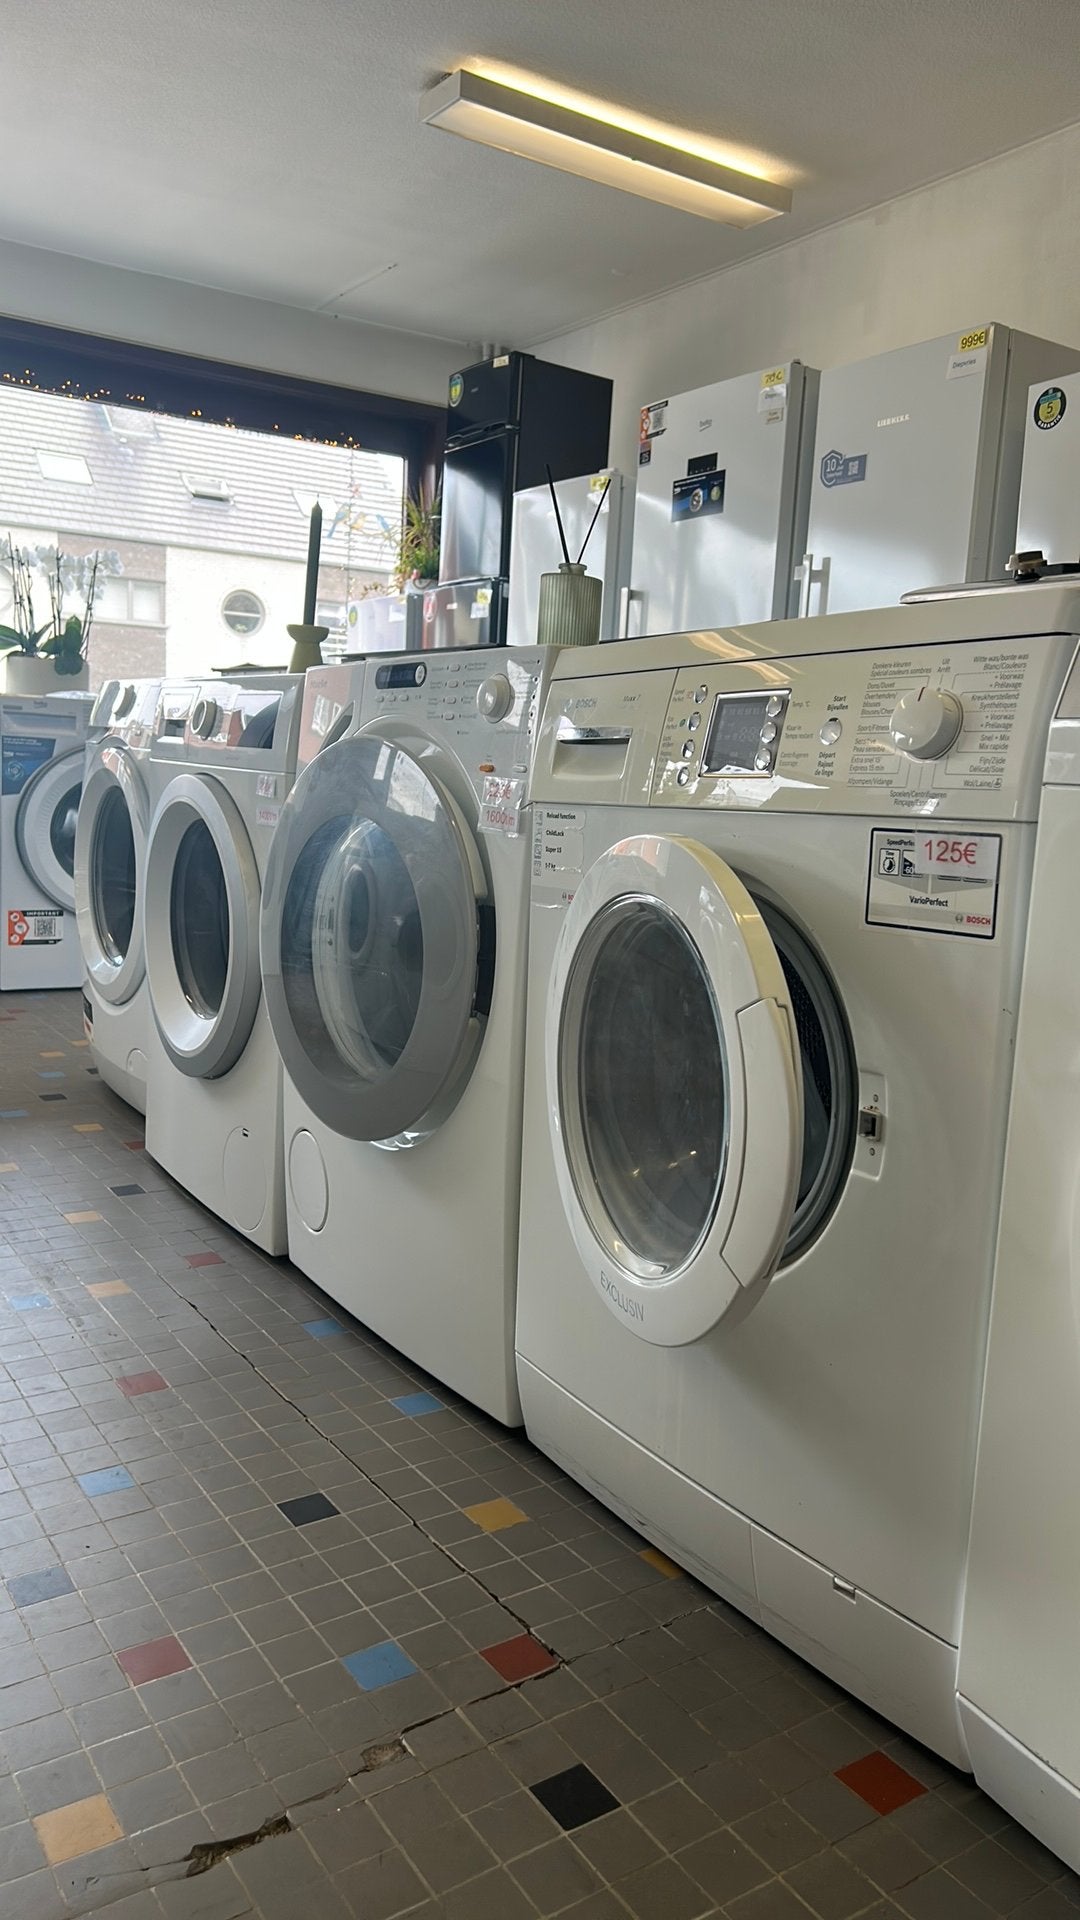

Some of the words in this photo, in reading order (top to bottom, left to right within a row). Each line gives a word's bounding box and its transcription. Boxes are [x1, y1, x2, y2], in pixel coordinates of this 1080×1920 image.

[961, 331, 984, 349] 999€
[1046, 401, 1053, 415] 5
[826, 459, 837, 472] 10
[1018, 653, 1029, 661] was
[983, 661, 1027, 671] Blanc/Couleurs
[991, 743, 1008, 751] rapide
[818, 752, 835, 760] Départ
[849, 763, 868, 772] Express
[821, 769, 833, 777] linge
[545, 846, 556, 854] Super
[924, 839, 978, 865] 125€
[909, 895, 949, 907] VarioPerfect
[966, 915, 991, 926] BOSCH
[600, 1270, 644, 1321] EXCLUSIV
